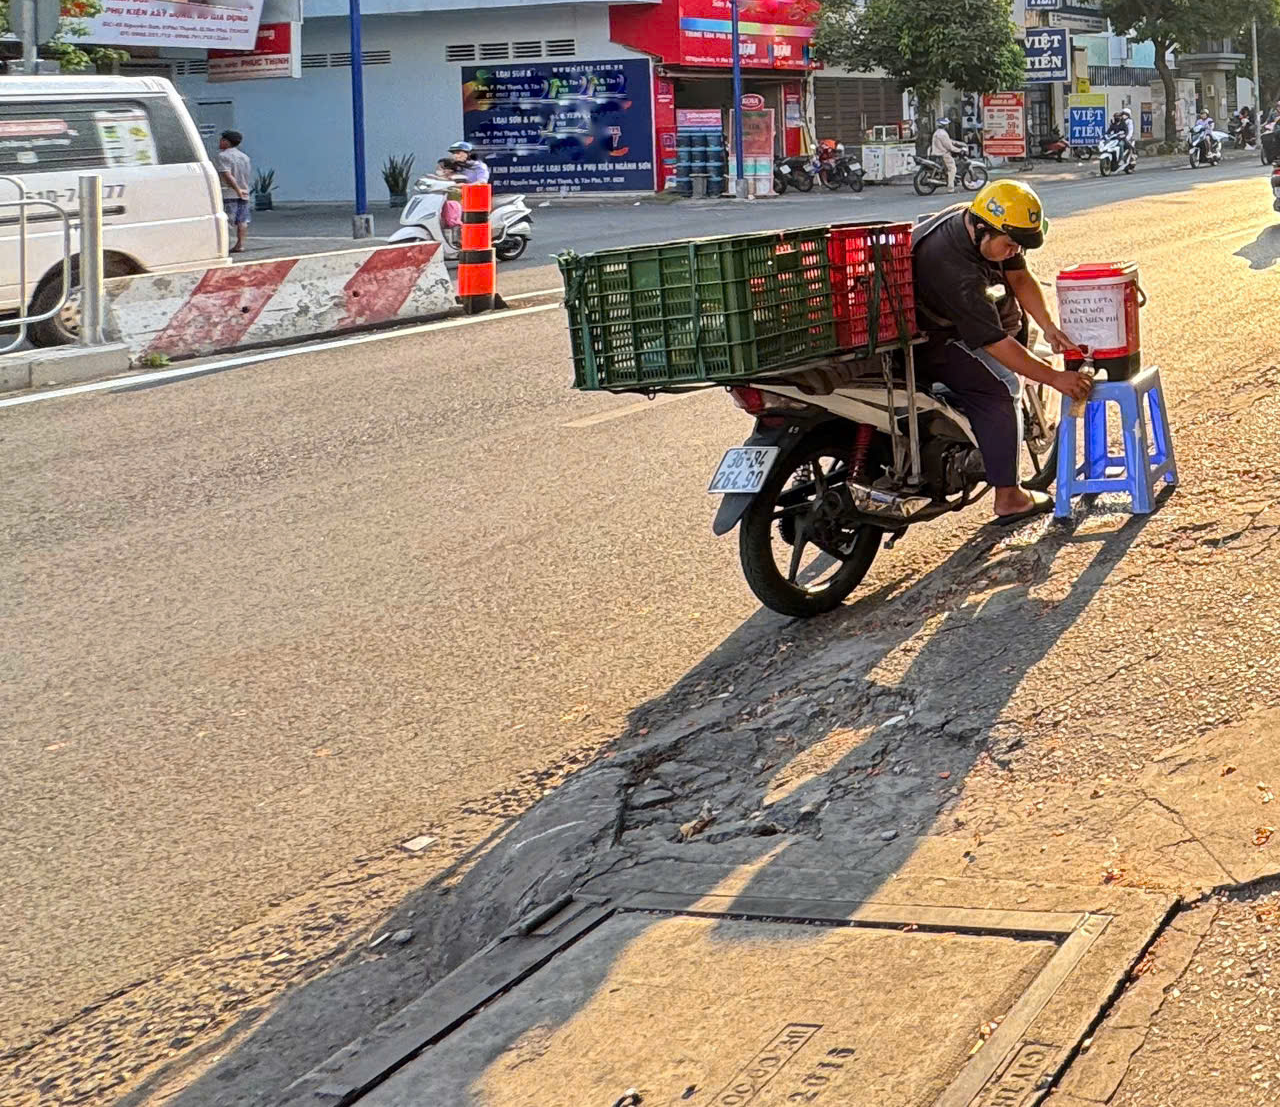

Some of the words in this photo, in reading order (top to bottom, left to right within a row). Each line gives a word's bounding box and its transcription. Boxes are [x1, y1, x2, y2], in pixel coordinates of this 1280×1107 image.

[1024, 32, 1061, 50] VIỆT
[1025, 51, 1063, 69] TIẾN
[1072, 107, 1103, 122] VIỆT
[1073, 122, 1103, 138] TIẾN
[986, 196, 1005, 217] be
